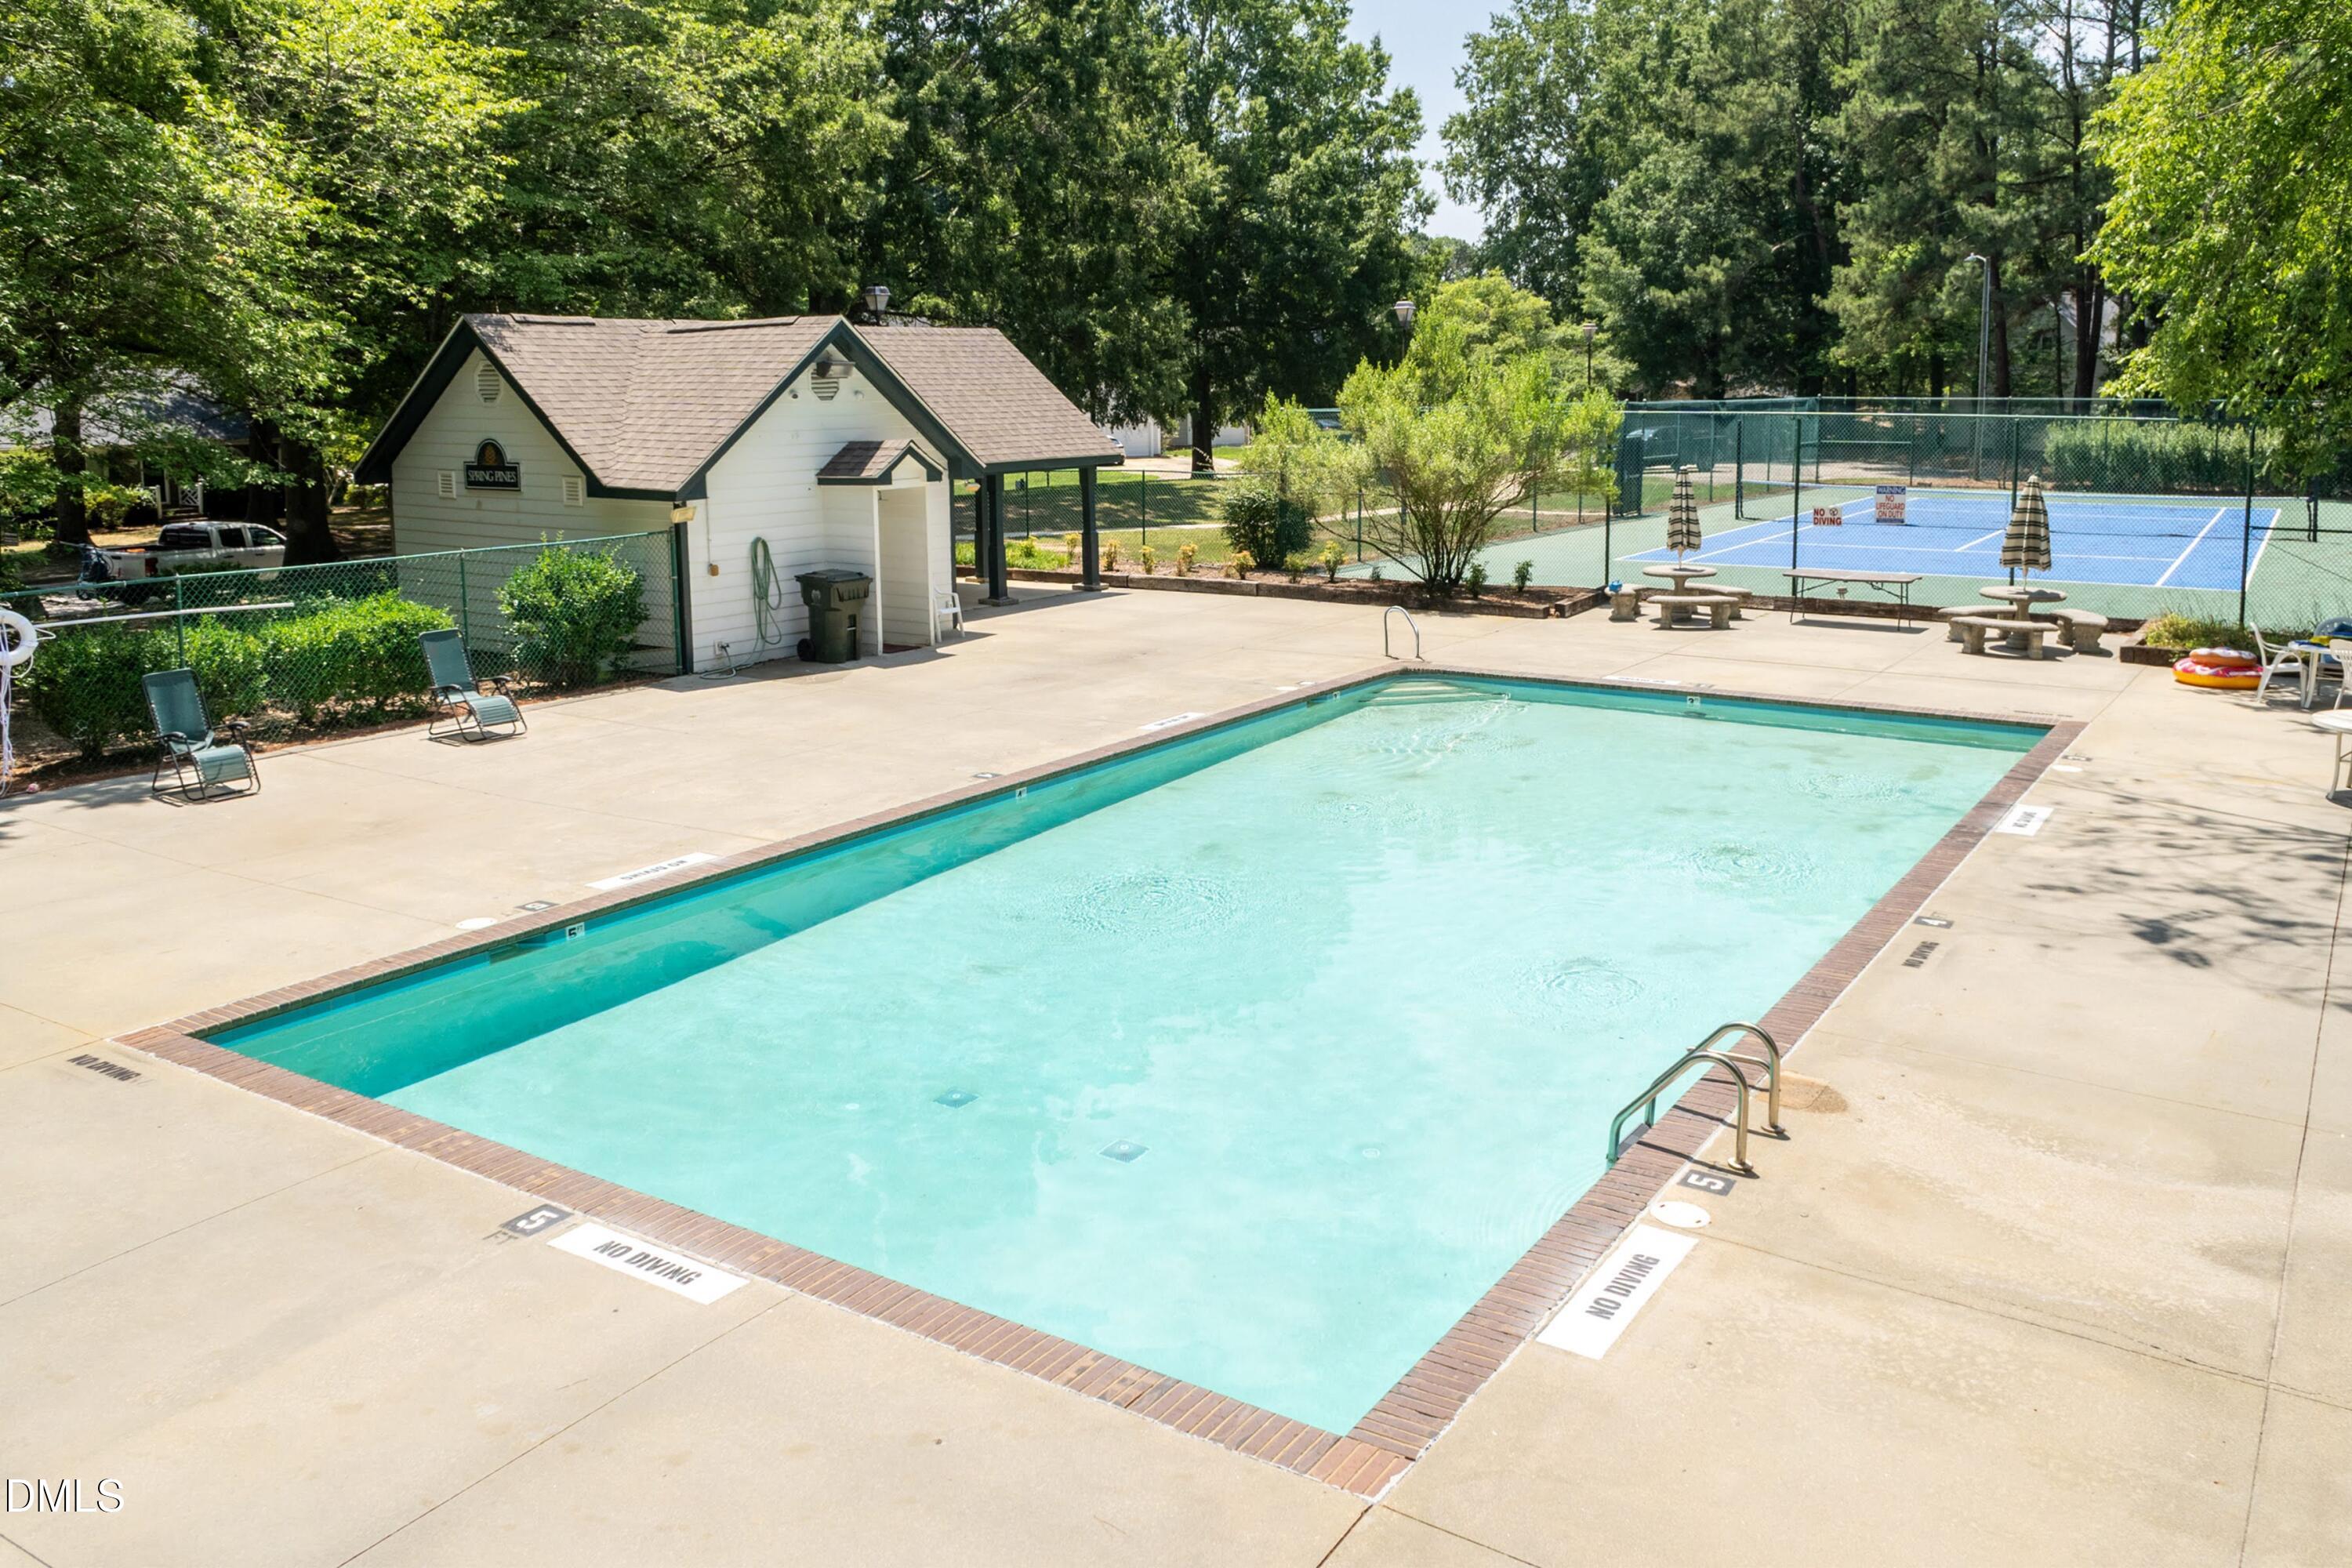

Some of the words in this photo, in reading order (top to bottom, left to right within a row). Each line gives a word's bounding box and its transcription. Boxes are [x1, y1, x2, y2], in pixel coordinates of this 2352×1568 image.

[467, 470, 494, 482] SPRING
[495, 470, 517, 483] PINES
[1813, 508, 1825, 517] NO
[1813, 517, 1842, 525] DIVING
[568, 927, 577, 939] 5
[1909, 941, 1940, 960] DIVING
[1901, 958, 1925, 969] NO
[66, 1054, 100, 1066] NO
[85, 1061, 142, 1081] DIVING
[1686, 1174, 1725, 1191] 5
[515, 1210, 559, 1230] 5
[593, 1240, 633, 1258] NO
[626, 1251, 702, 1285] DIVING
[1584, 1296, 1621, 1320] NO
[1603, 1254, 1661, 1298] DIVING
